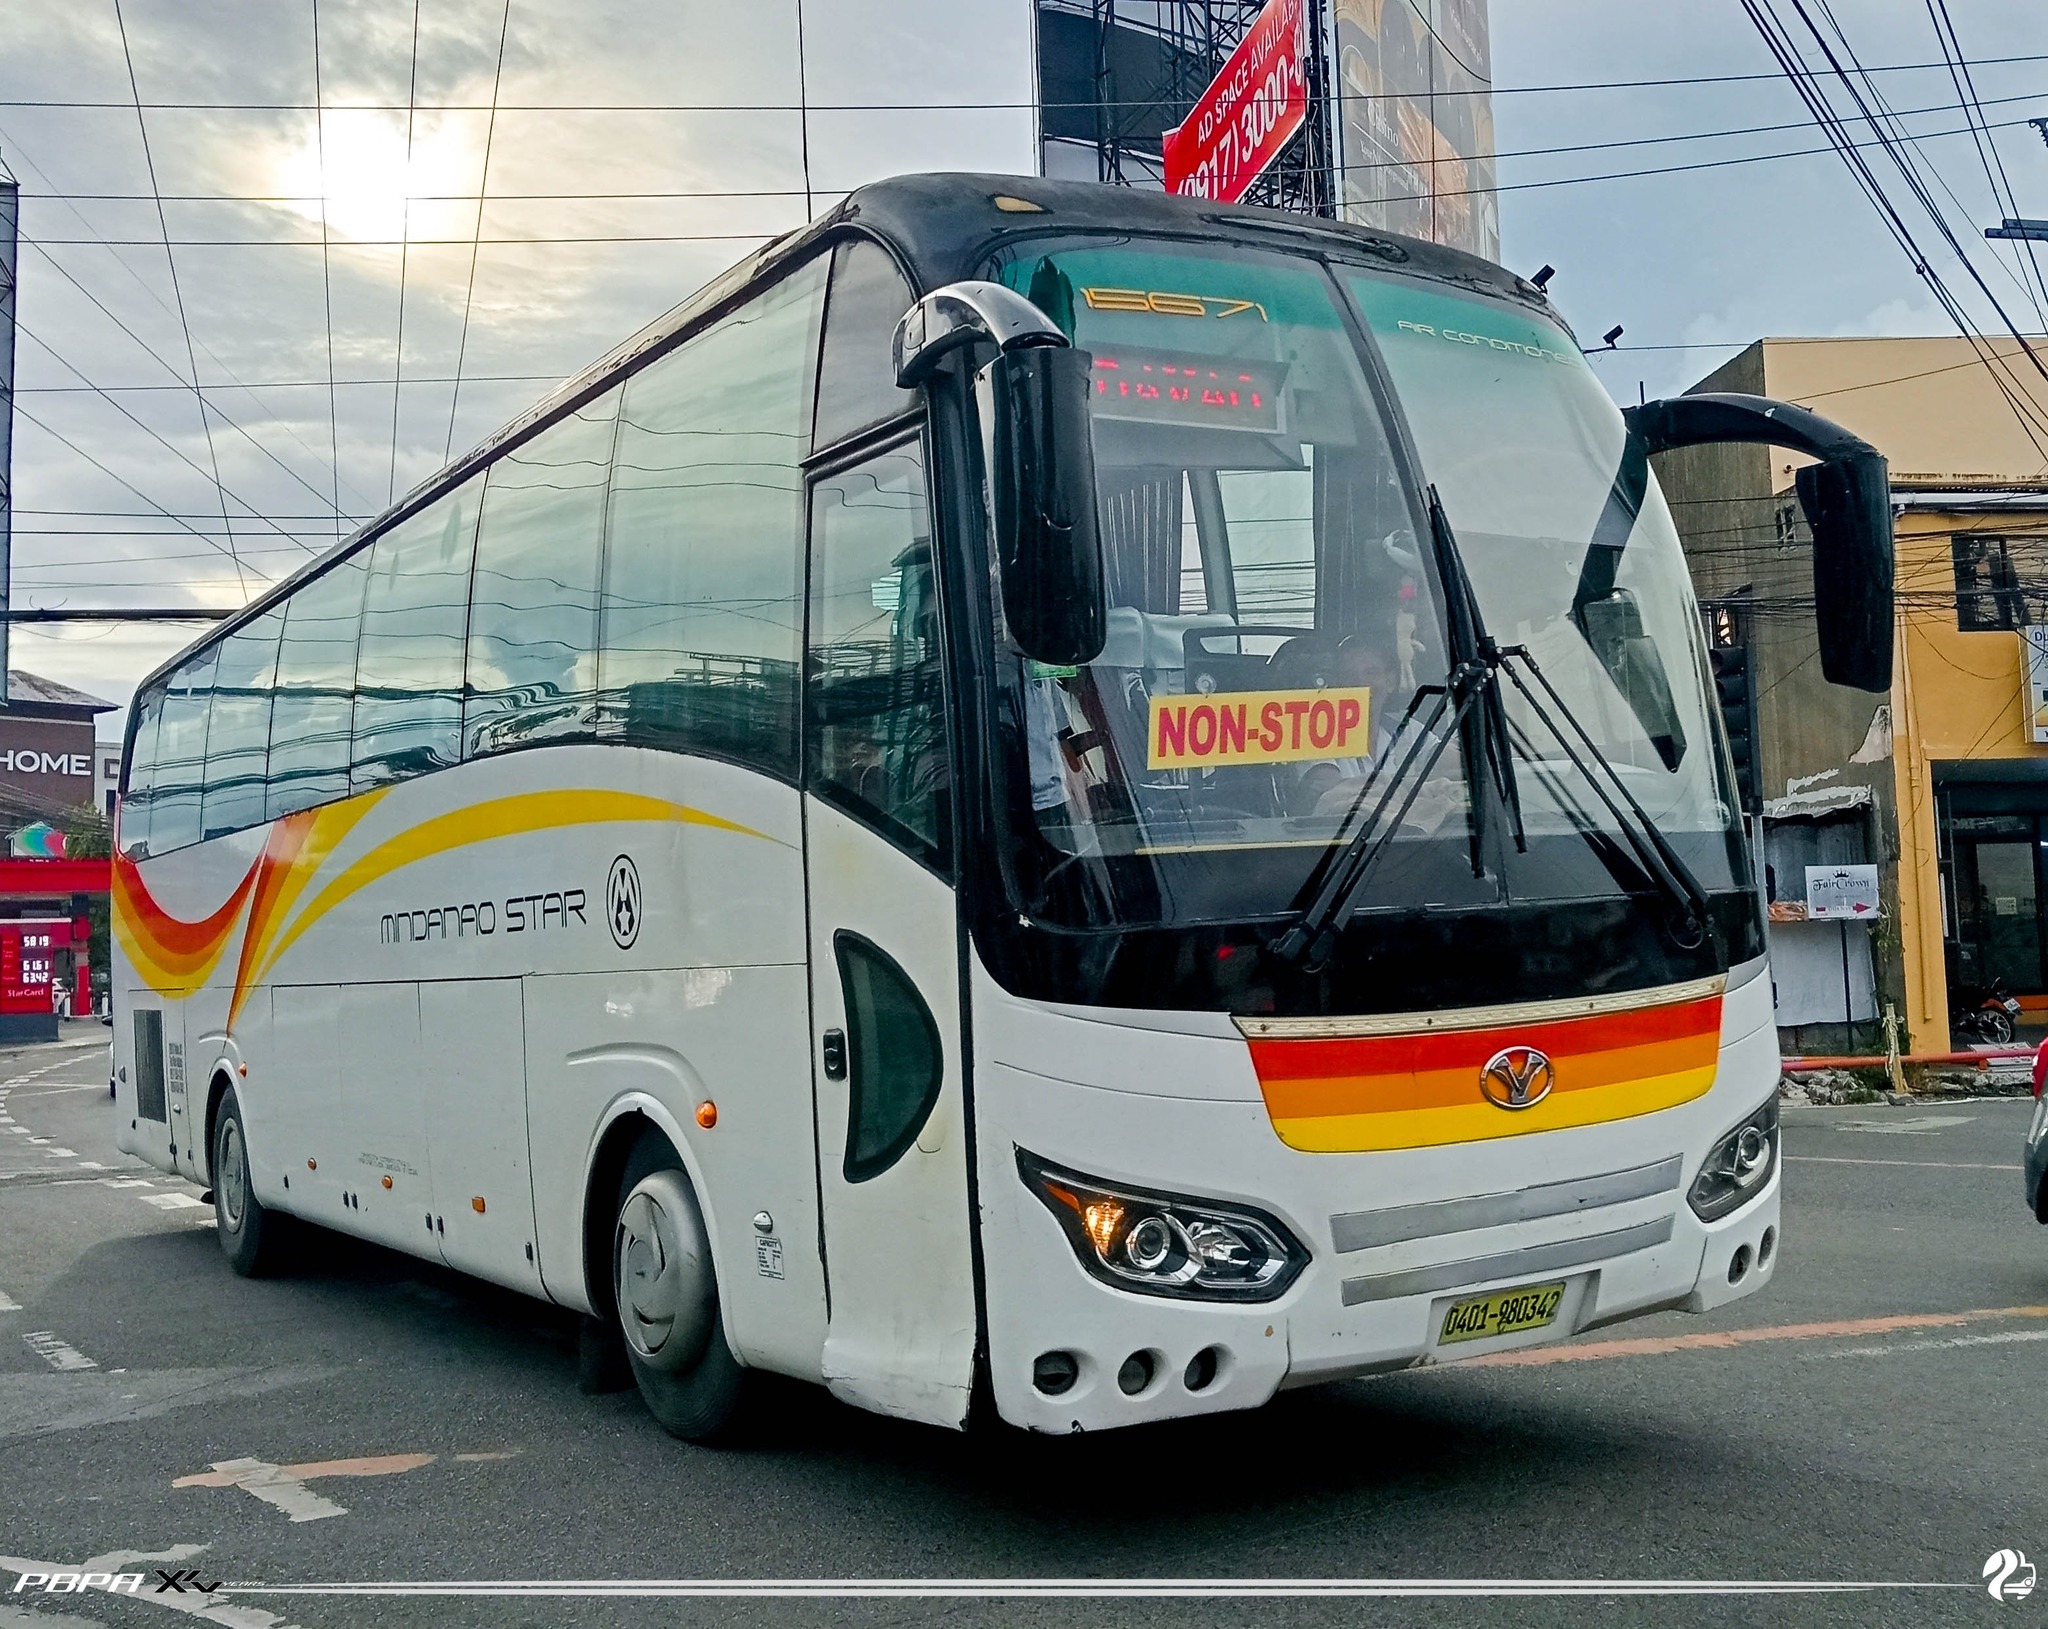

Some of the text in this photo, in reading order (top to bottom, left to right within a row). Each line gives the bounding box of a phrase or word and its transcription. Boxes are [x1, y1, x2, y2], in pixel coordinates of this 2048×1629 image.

[1198, 0, 1299, 148] AD SPACE AVAILAB
[1397, 320, 1436, 337] AIR
[1158, 699, 1361, 757] NON-STOP
[0, 749, 92, 776] HOME
[381, 889, 587, 944] MINDANAO STAR
[7, 988, 44, 997] StarCard
